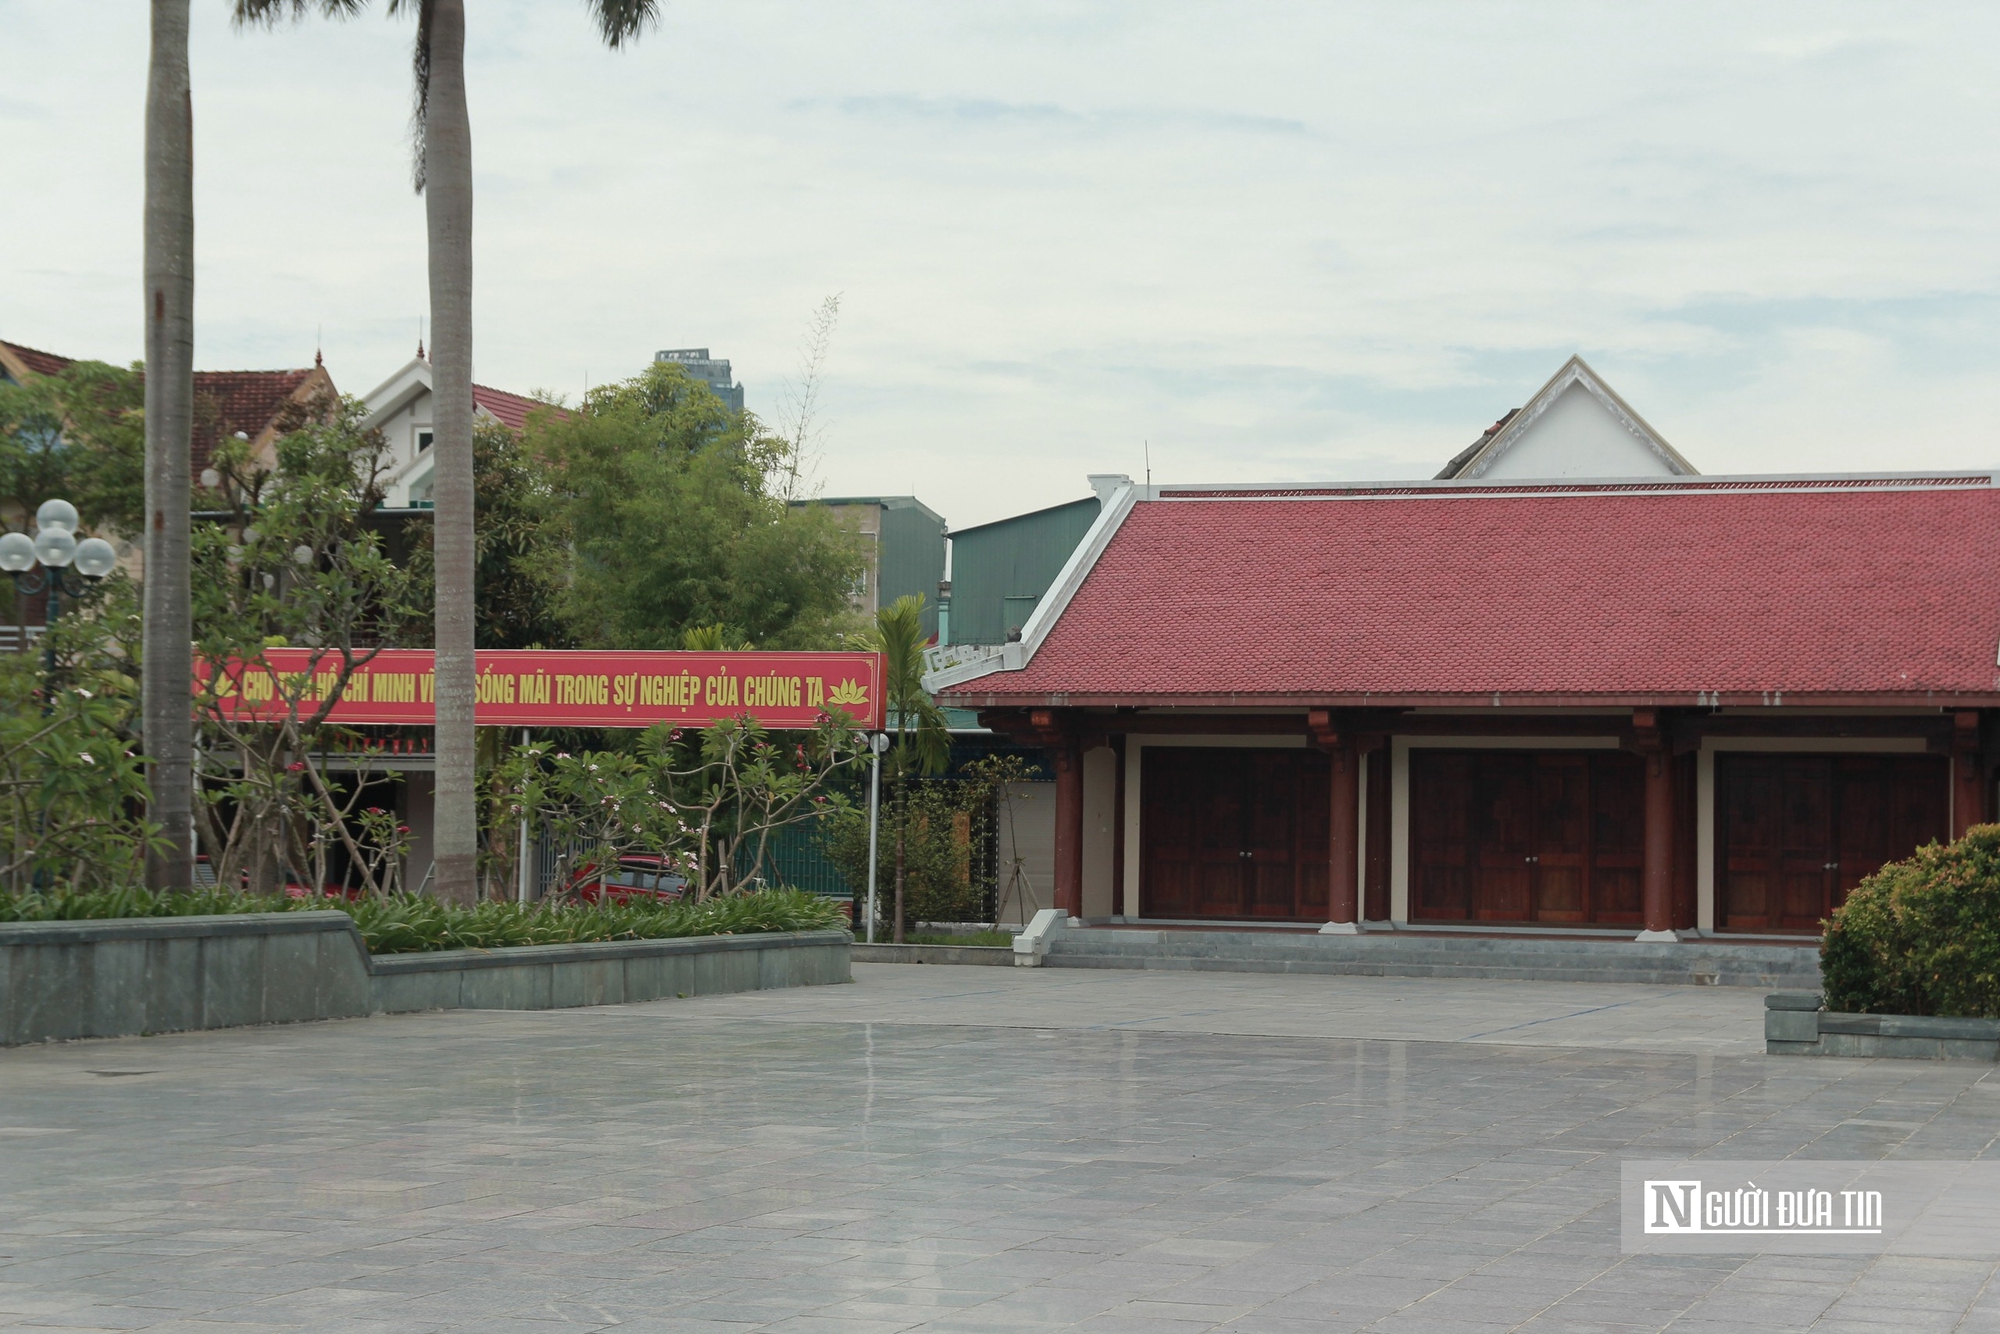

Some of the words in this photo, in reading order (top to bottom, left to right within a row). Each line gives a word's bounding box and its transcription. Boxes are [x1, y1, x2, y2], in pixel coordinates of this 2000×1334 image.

[277, 671, 312, 708] TỊH
[342, 667, 369, 702] CHÍ
[373, 673, 415, 703] MINH
[475, 663, 515, 704] SỐNG
[519, 668, 550, 705] MÃI
[555, 675, 608, 705] TRONG
[613, 672, 638, 711] SỰ
[640, 669, 700, 712] NGHIỆP
[705, 666, 739, 706] CỦA
[744, 670, 800, 707] CHÚNG
[806, 676, 824, 707] TA
